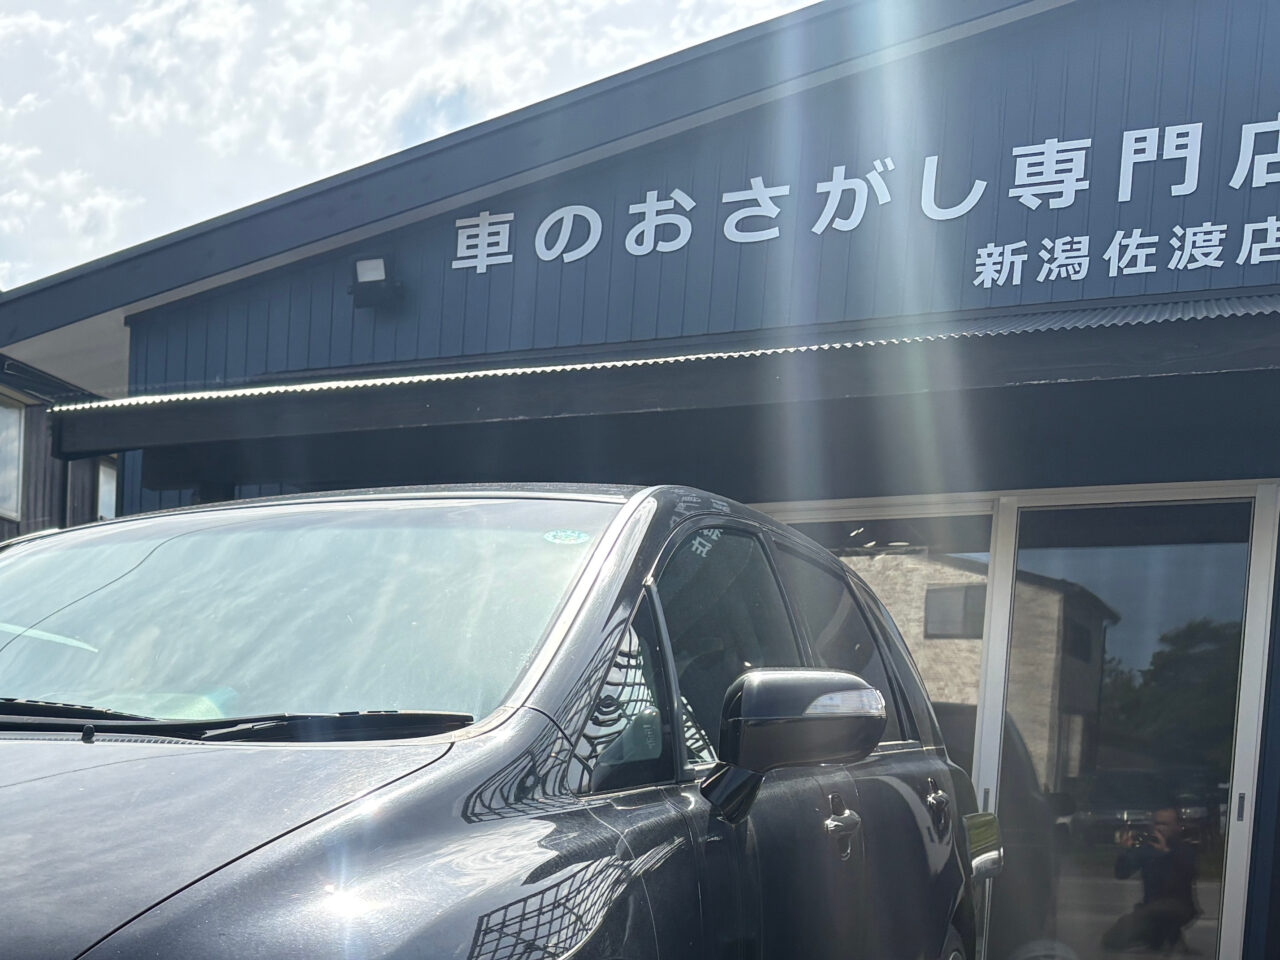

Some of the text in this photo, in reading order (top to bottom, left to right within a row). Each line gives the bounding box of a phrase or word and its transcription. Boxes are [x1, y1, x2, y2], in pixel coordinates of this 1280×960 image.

[973, 216, 1280, 288] 新潟佐渡店
